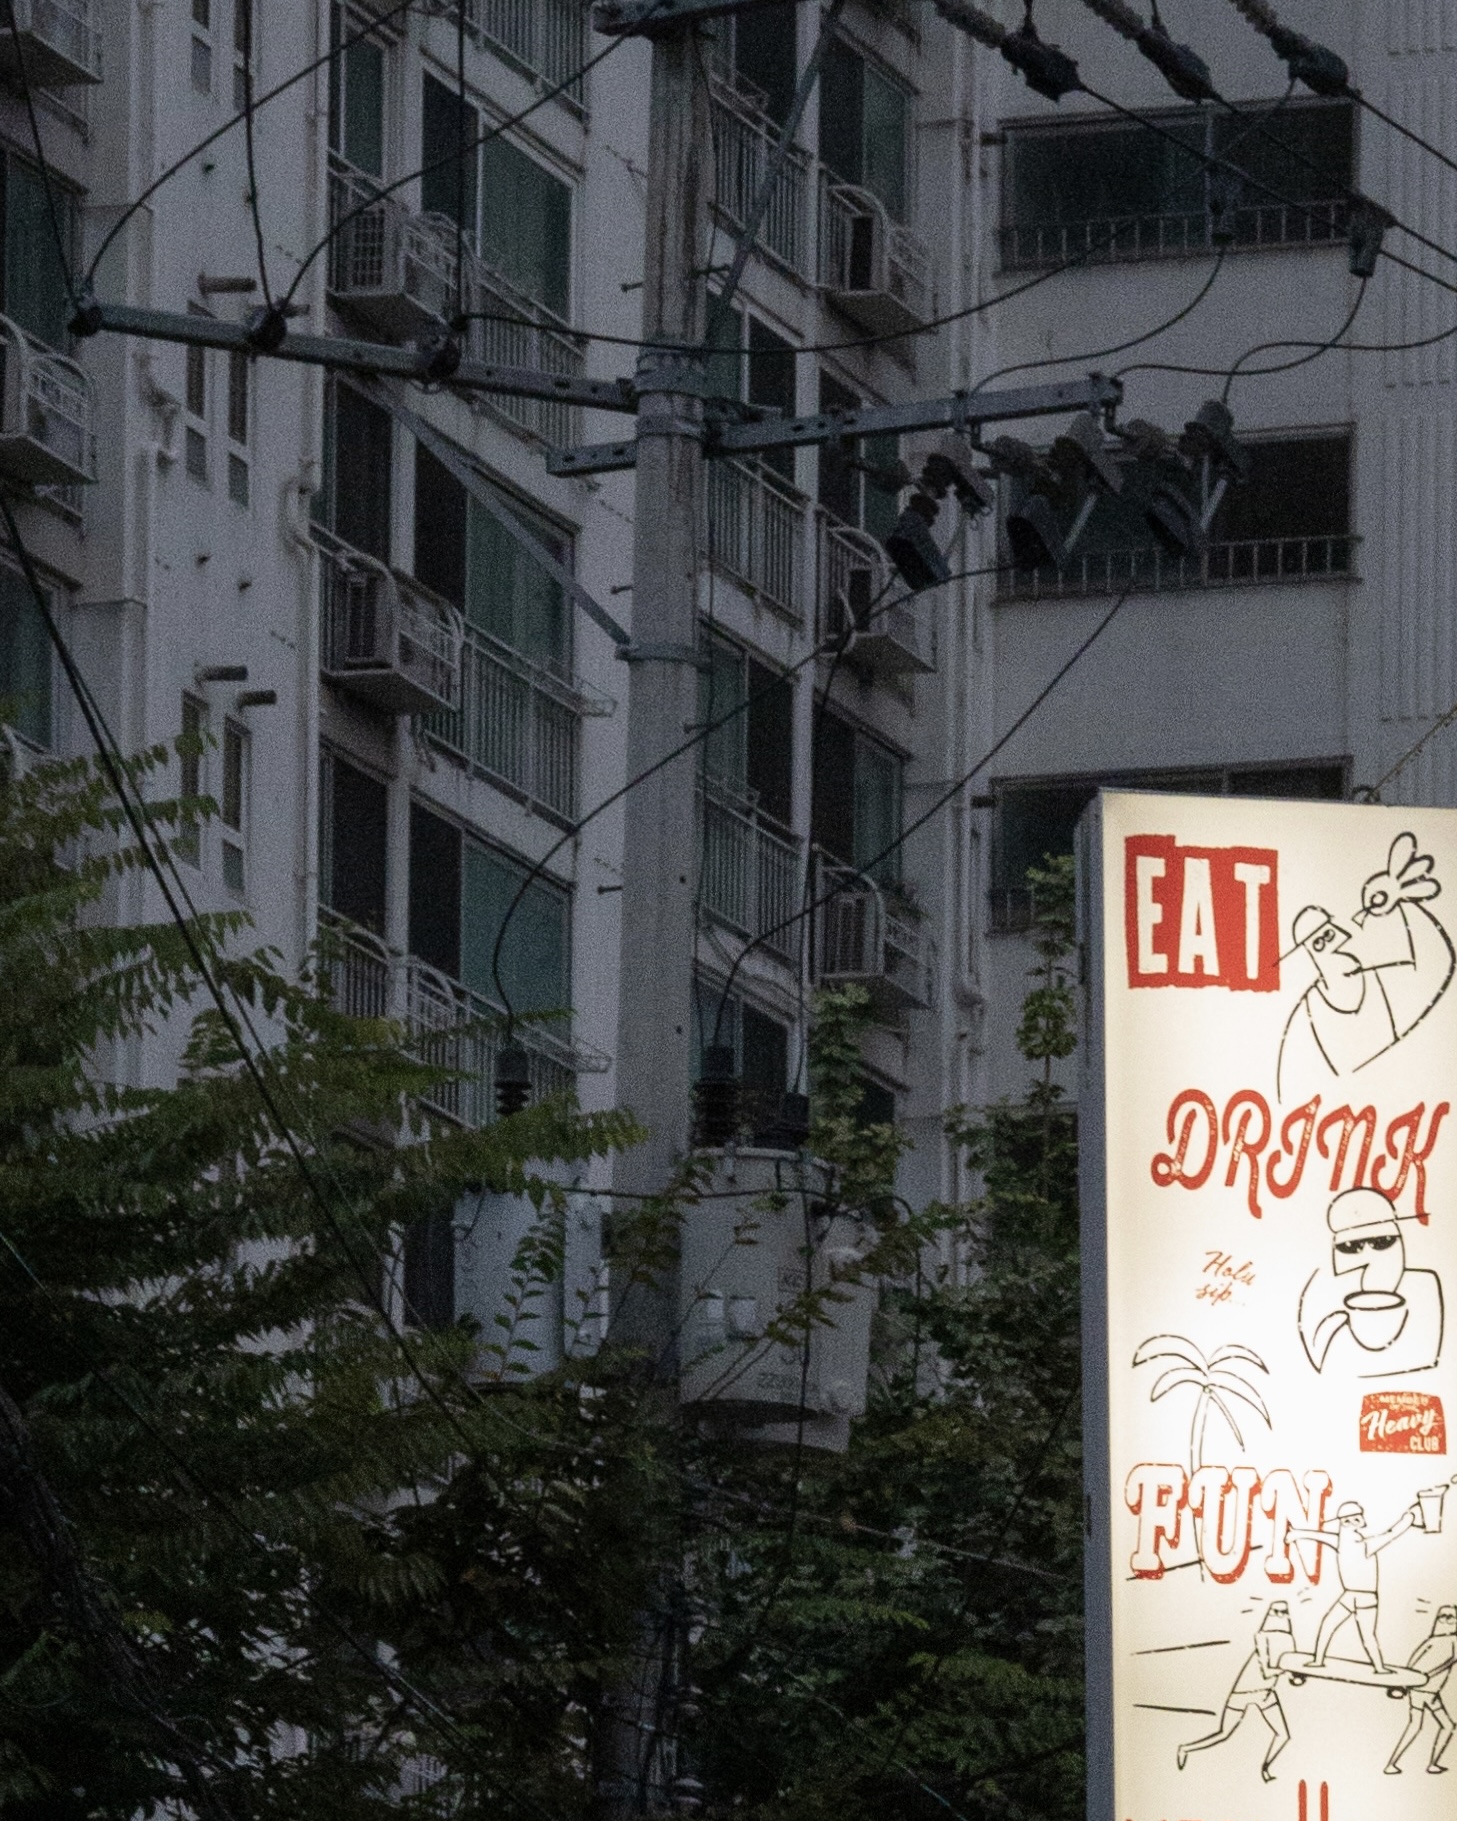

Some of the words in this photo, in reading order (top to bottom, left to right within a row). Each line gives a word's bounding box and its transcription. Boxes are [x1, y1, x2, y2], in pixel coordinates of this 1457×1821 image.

[1136, 857, 1271, 981] EAT
[1151, 1088, 1450, 1227] DRINK
[1360, 1408, 1436, 1441] Heavy
[1409, 1436, 1440, 1452] CLUB
[1126, 1464, 1332, 1584] FUN
